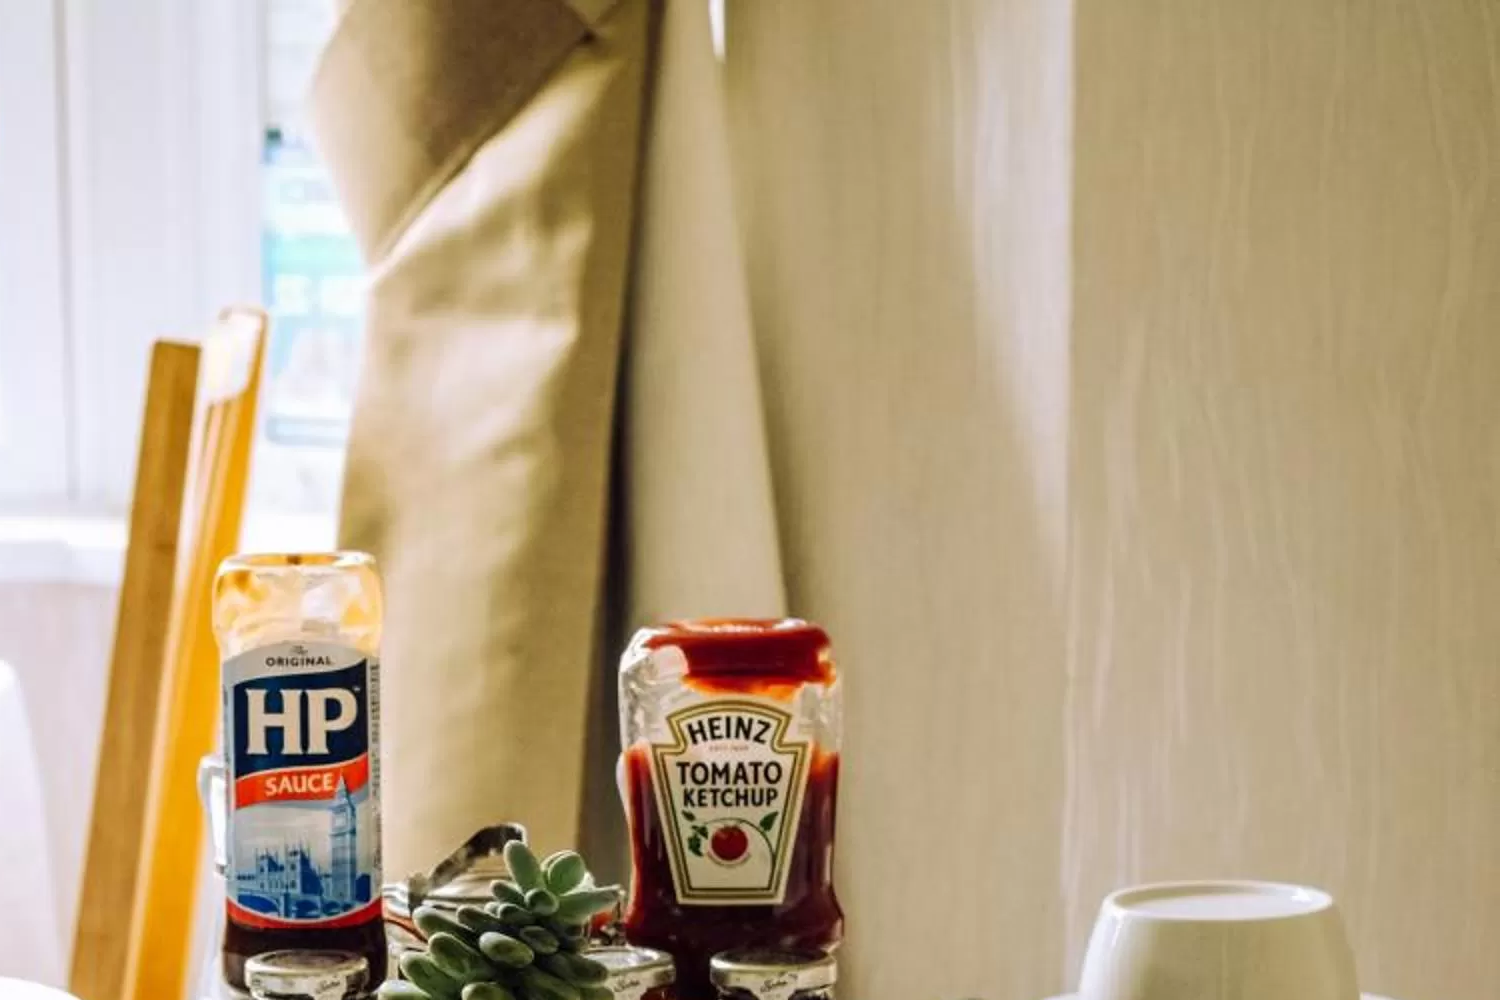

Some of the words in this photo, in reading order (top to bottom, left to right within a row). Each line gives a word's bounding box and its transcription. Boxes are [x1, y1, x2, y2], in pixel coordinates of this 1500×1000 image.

[265, 655, 333, 668] ORIGINAL
[245, 688, 358, 756] HP
[687, 715, 772, 746] HEINZ
[264, 772, 334, 797] SAUCE
[675, 761, 783, 786] TOMATO
[682, 787, 778, 808] KETCHUP
